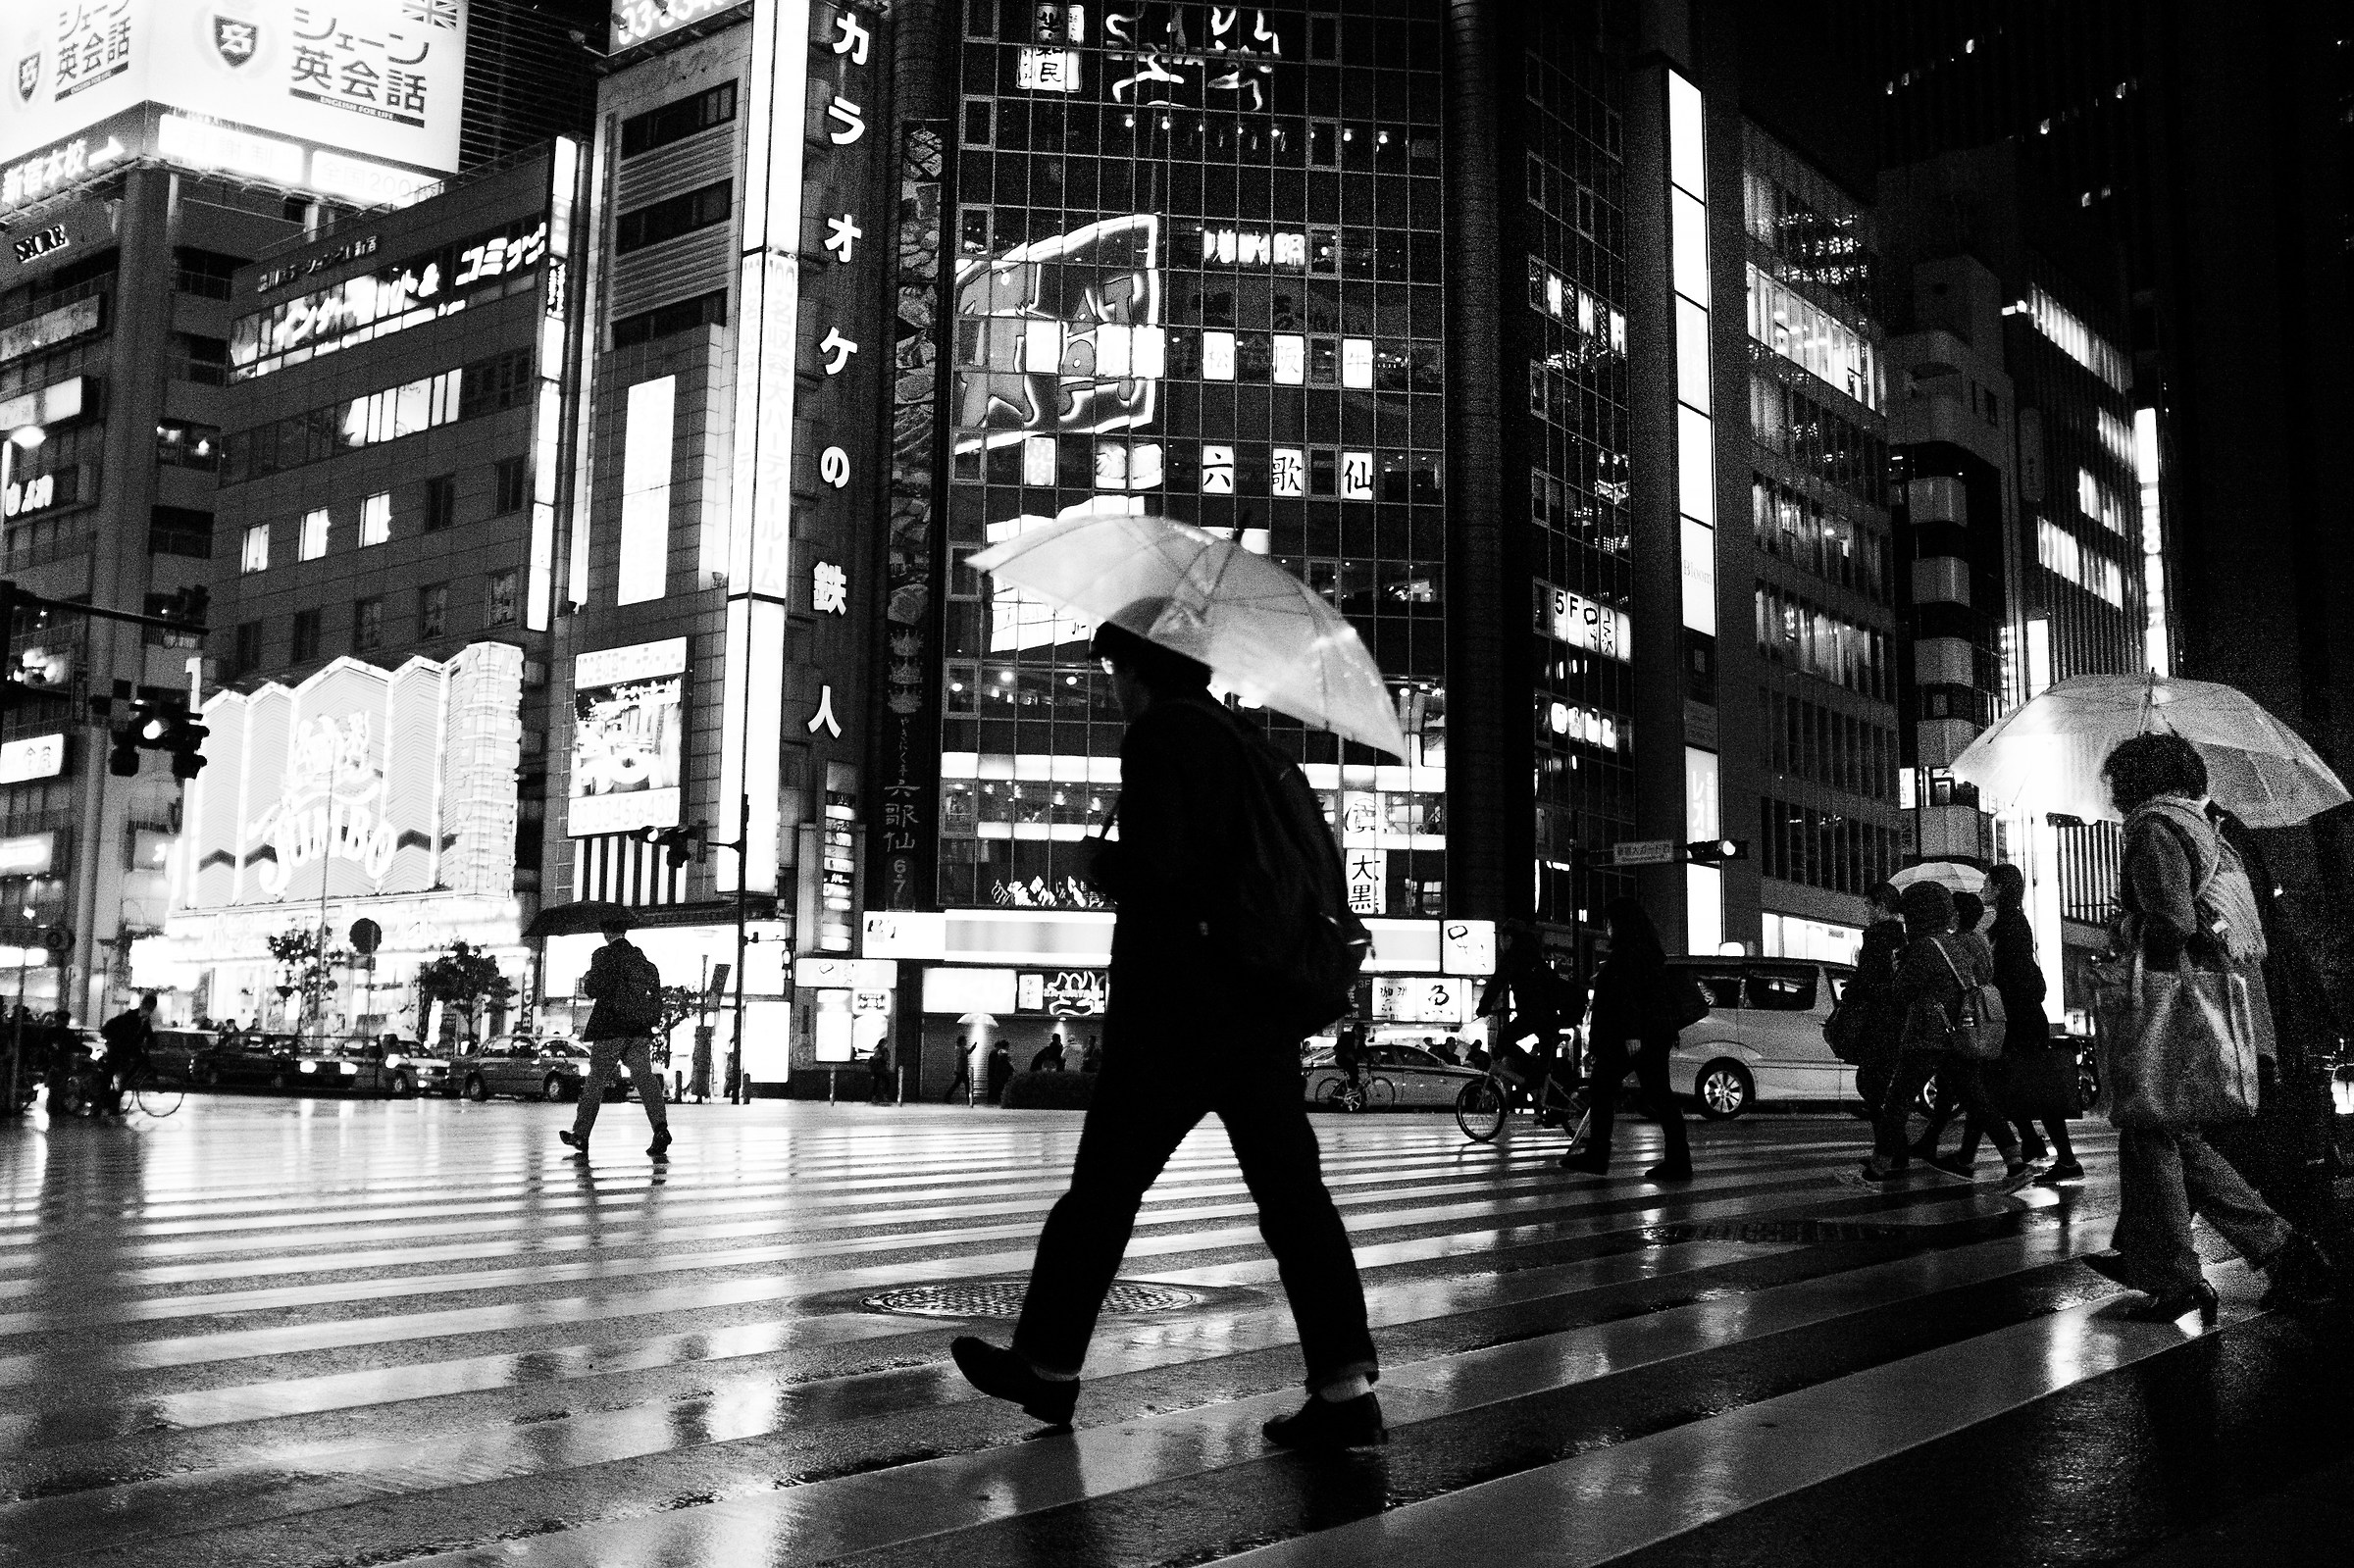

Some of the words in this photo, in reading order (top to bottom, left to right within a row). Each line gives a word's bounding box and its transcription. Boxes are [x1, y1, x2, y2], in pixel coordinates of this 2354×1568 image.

[55, 16, 131, 86] 英会話
[291, 6, 430, 66] シェーン
[289, 45, 428, 115] 英会話
[320, 96, 358, 112] ENGLISH
[358, 104, 375, 116] FOR
[1, 138, 86, 204] 新宿本校
[807, 12, 871, 739] カラオケの鉄人
[1202, 452, 1374, 495] 六歌仙
[1683, 559, 1713, 585] Bloom
[1555, 590, 1579, 619] 5F
[884, 779, 921, 853] 六歌仙
